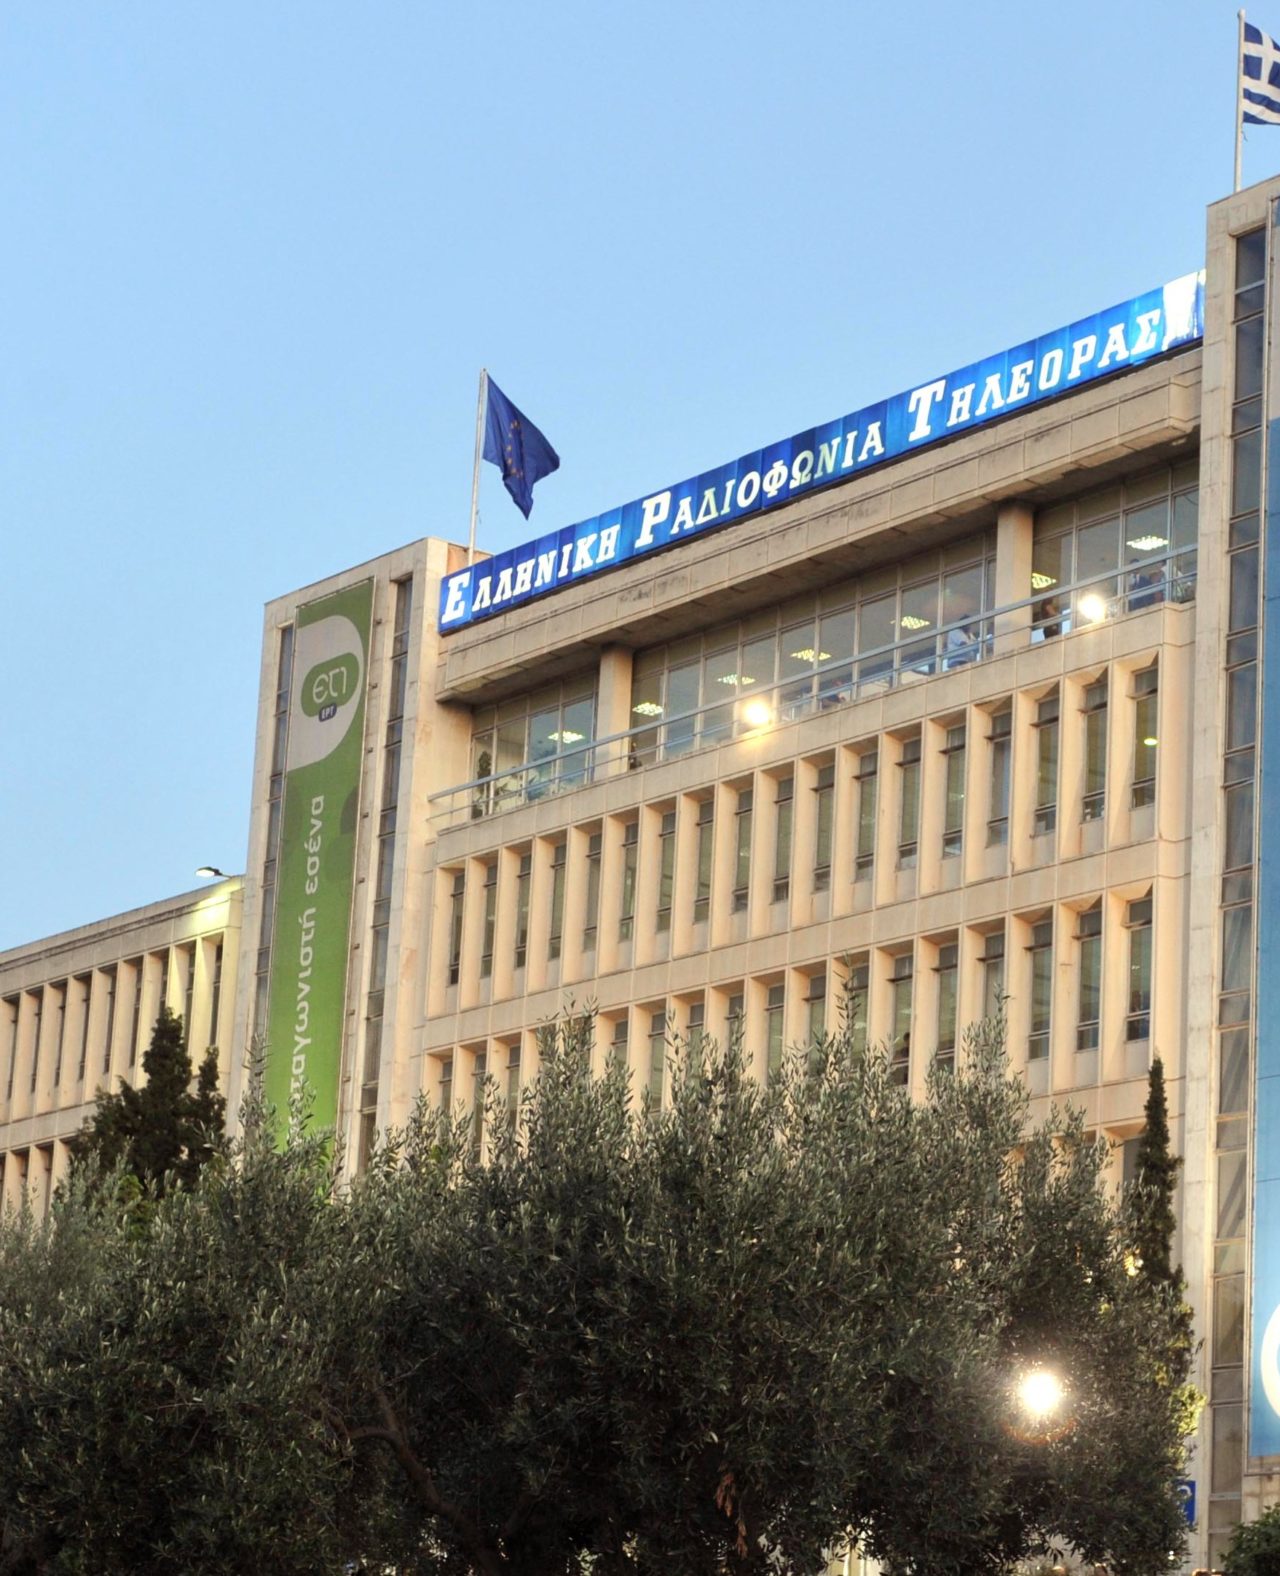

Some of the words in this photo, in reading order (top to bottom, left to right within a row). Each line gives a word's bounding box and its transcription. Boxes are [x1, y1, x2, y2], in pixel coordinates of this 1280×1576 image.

[441, 523, 621, 624] ΕΛΛΗΝΙΚΗ
[634, 421, 885, 548] ΡΑΔΙΟΦΩΝΙΑ
[908, 292, 1197, 442] ΤΗΛΕΟΡΑΣ
[303, 794, 325, 896] εσένα
